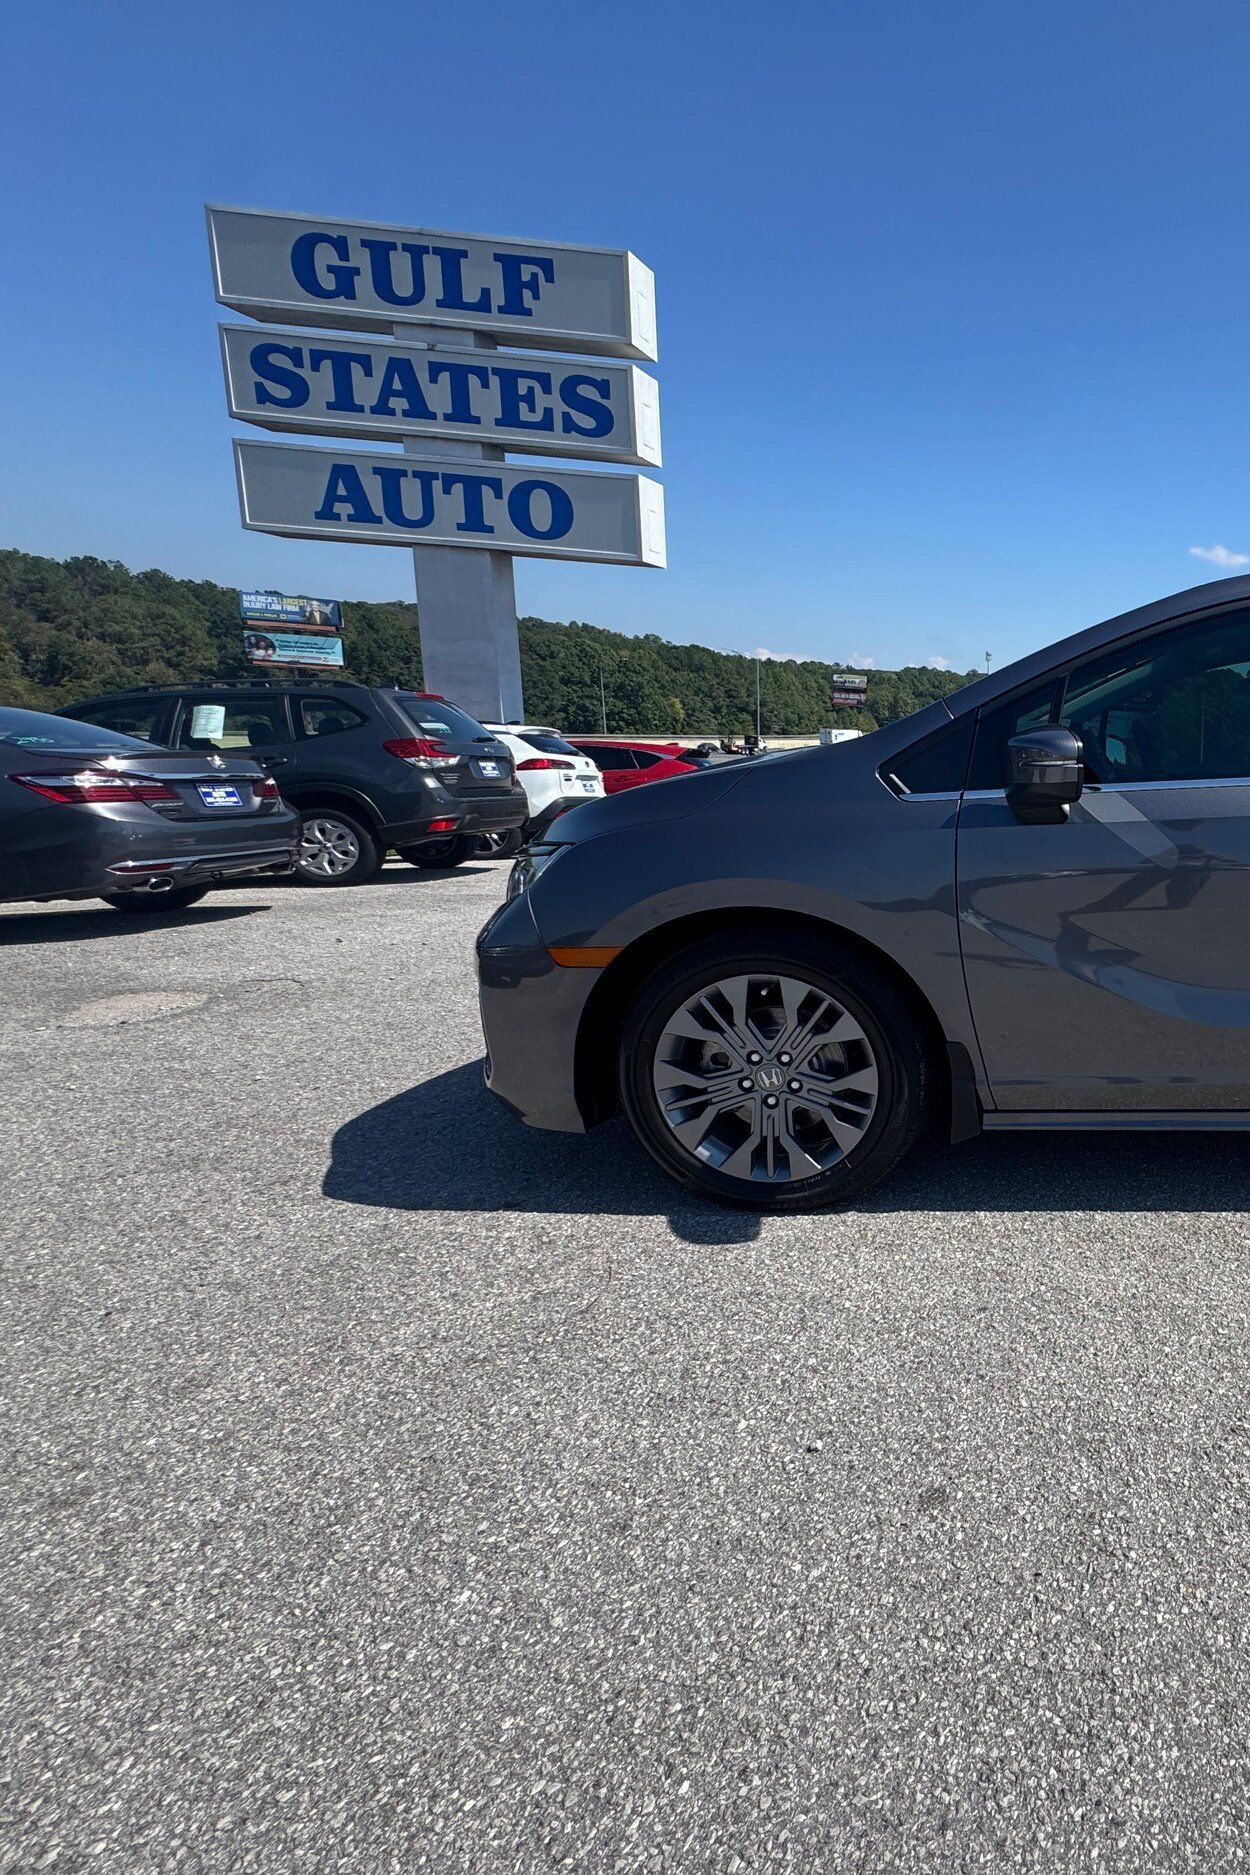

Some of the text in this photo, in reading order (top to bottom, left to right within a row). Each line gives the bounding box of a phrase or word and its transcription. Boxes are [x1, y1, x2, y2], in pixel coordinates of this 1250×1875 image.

[290, 232, 555, 317] GULF
[249, 342, 615, 439] STATES
[314, 463, 575, 541] AUTO
